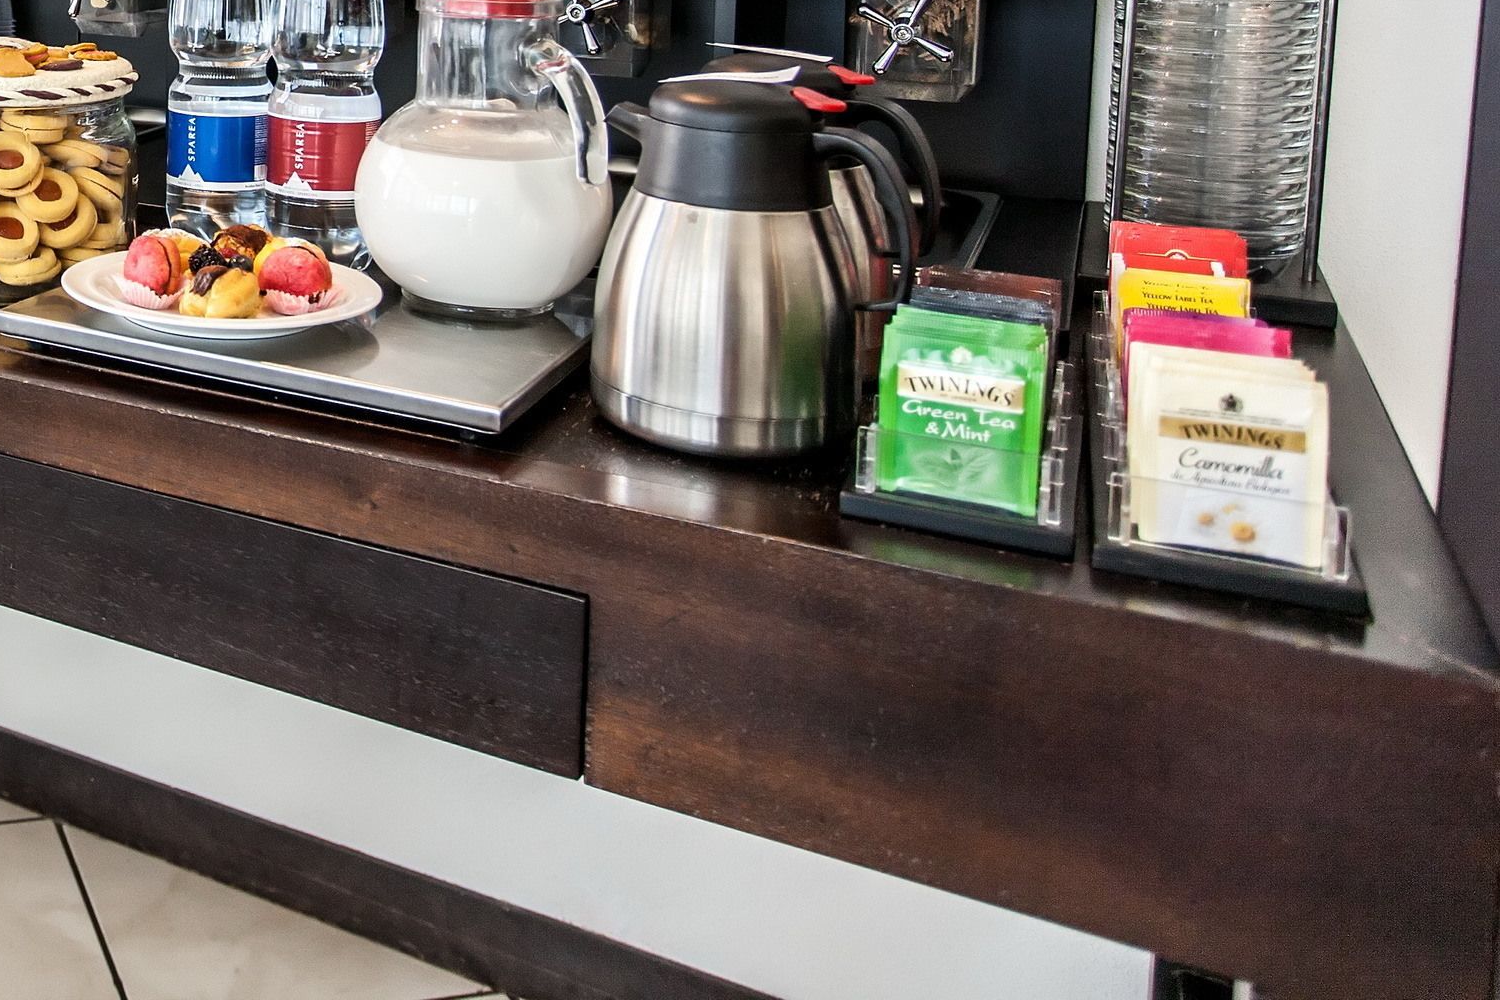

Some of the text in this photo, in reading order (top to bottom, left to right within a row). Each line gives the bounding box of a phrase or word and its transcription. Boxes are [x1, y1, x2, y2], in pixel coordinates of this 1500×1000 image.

[187, 117, 197, 162] SPAREA
[295, 123, 305, 170] SPAREA
[904, 375, 1017, 407] TWININGS
[902, 399, 1016, 430] Green Tea
[925, 421, 992, 443] & Mint
[1179, 423, 1285, 450] TWININGS
[1178, 446, 1284, 480] Camomilla
